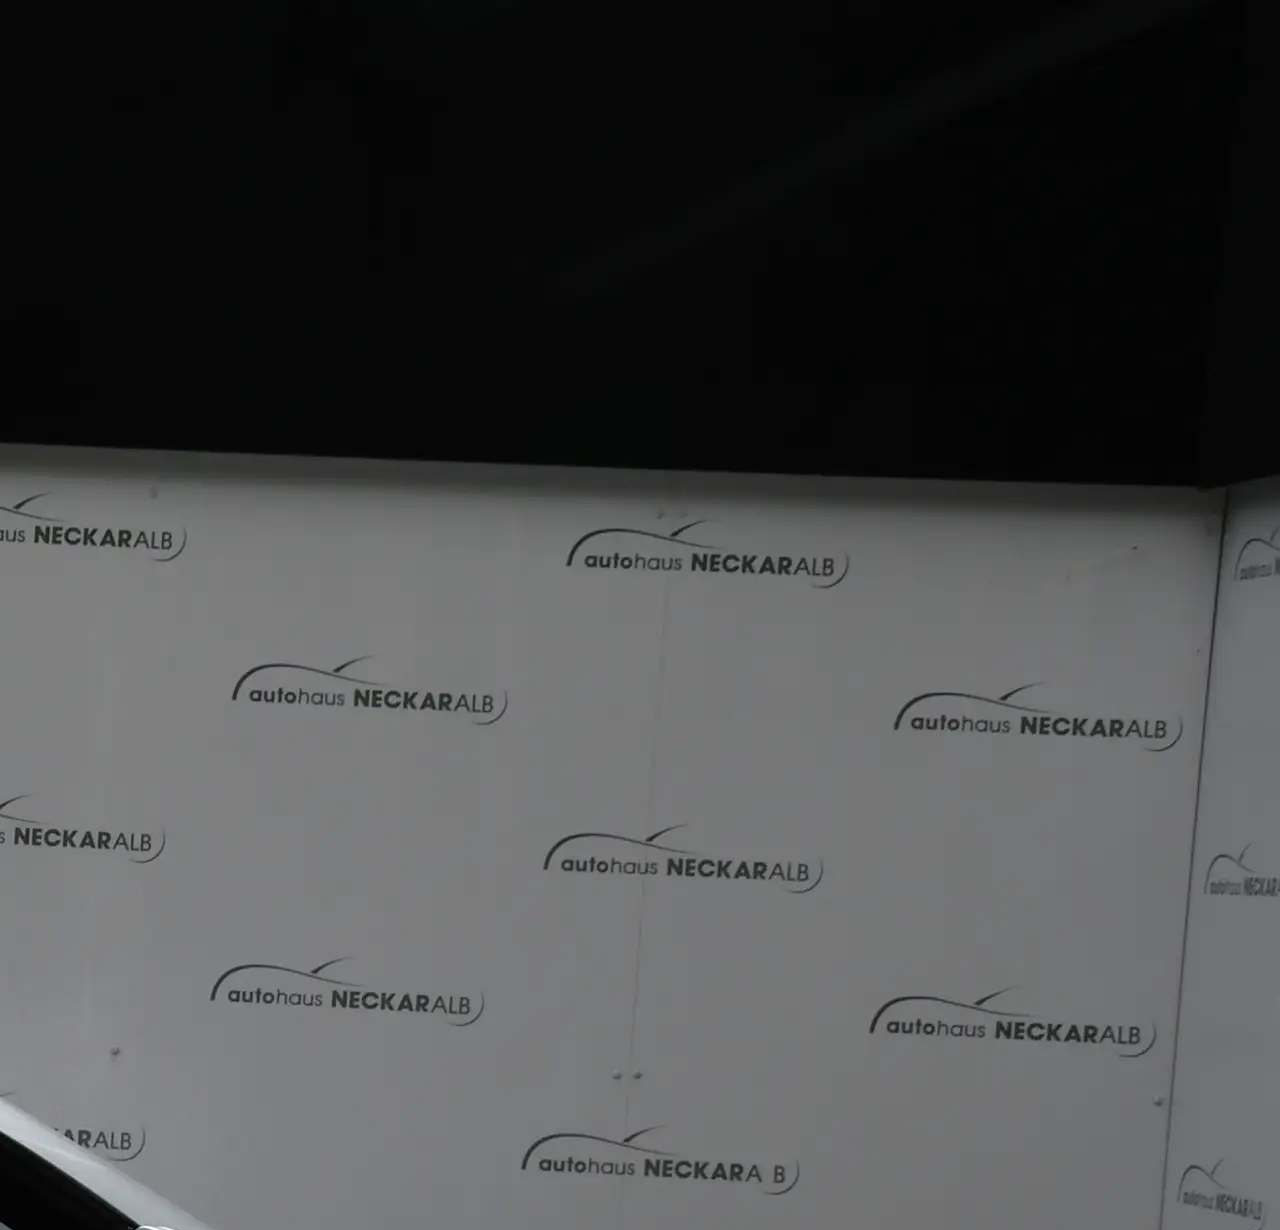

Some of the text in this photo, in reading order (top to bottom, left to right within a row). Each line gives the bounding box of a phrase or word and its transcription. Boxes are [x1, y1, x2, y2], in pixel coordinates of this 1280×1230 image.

[34, 525, 173, 551] NECKARALB
[584, 553, 835, 578] autohaus NECKARALB
[249, 688, 494, 714] autohaus NECKARALB
[911, 714, 1169, 741] autohaus NECKARALB
[14, 827, 151, 852] NECKARALB
[561, 857, 809, 883] autohaus NECKARALB
[228, 988, 470, 1015] autohaus NECKARALB
[886, 1018, 1143, 1047] autohaus NECKARALB
[539, 1157, 635, 1175] autohaus
